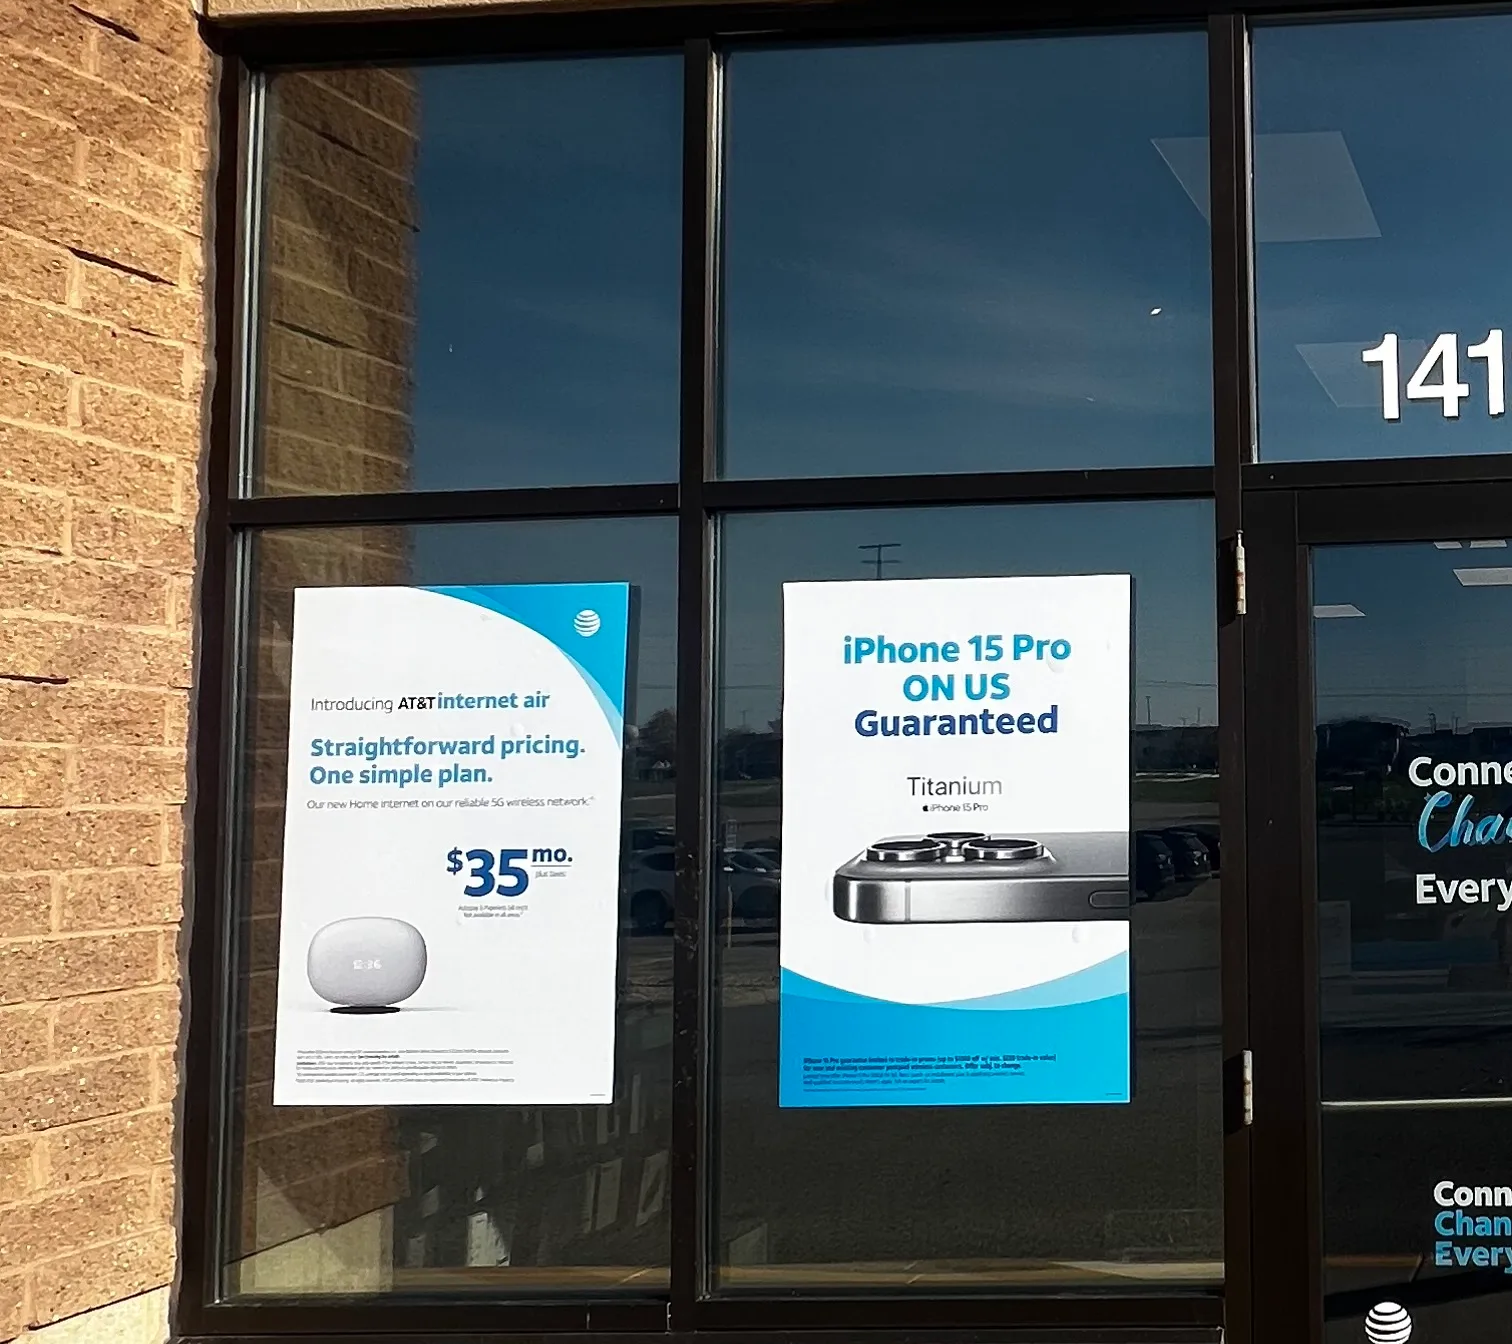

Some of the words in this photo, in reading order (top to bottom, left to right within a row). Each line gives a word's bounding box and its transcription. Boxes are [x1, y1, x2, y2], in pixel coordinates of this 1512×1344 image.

[843, 635, 960, 664] iPhone
[968, 635, 1003, 662] 15
[1013, 634, 1072, 660] Pro
[903, 674, 955, 702] ON
[965, 673, 1010, 700] US
[310, 697, 393, 714] Introducing
[398, 697, 436, 711] AT&T
[438, 692, 518, 710] internet
[523, 691, 550, 709] air
[855, 705, 1058, 737] Guaranteed
[310, 735, 495, 761] Straightforward
[501, 735, 585, 759] pricing.
[310, 766, 353, 785] One
[359, 763, 433, 788] simple
[438, 763, 493, 787] plan.
[906, 775, 1003, 797] Titanium
[446, 846, 529, 897] $35
[532, 847, 573, 863] mo.
